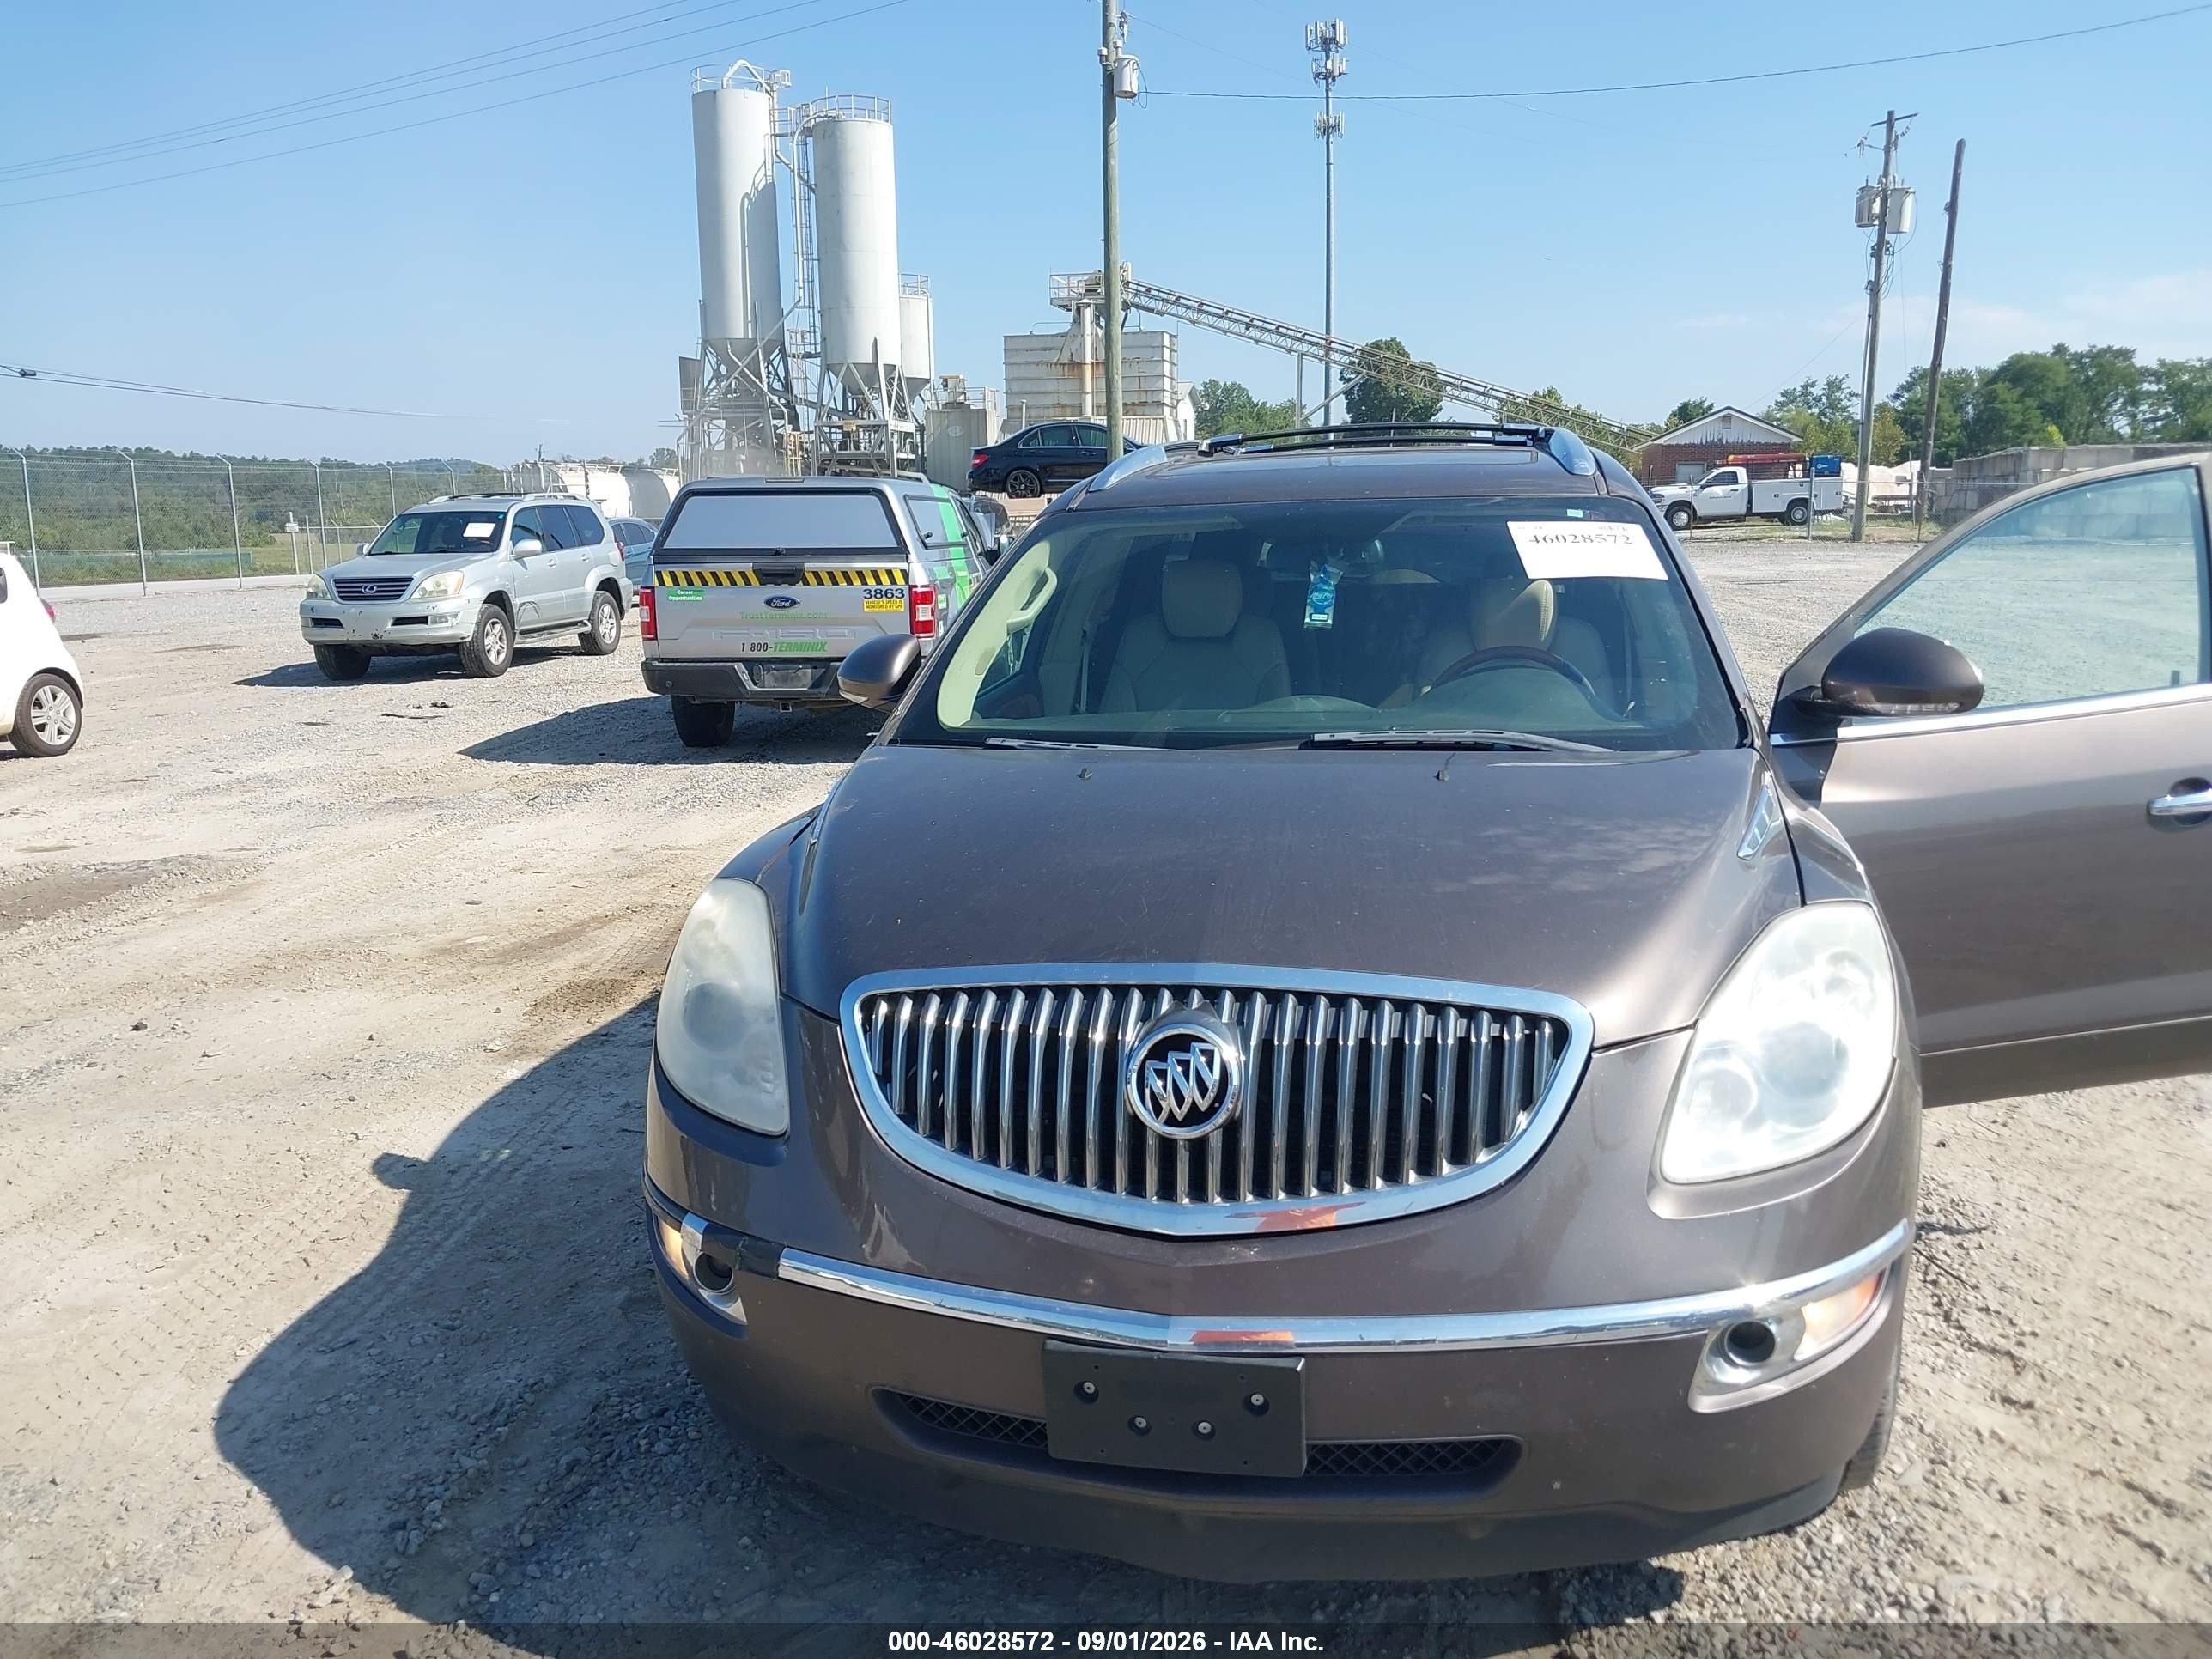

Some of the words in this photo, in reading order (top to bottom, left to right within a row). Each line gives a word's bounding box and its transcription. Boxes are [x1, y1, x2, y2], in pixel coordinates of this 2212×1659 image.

[1528, 534, 1633, 544] 46028572
[862, 588, 906, 599] 3863
[770, 598, 792, 607] Ford
[712, 628, 857, 640] F-150
